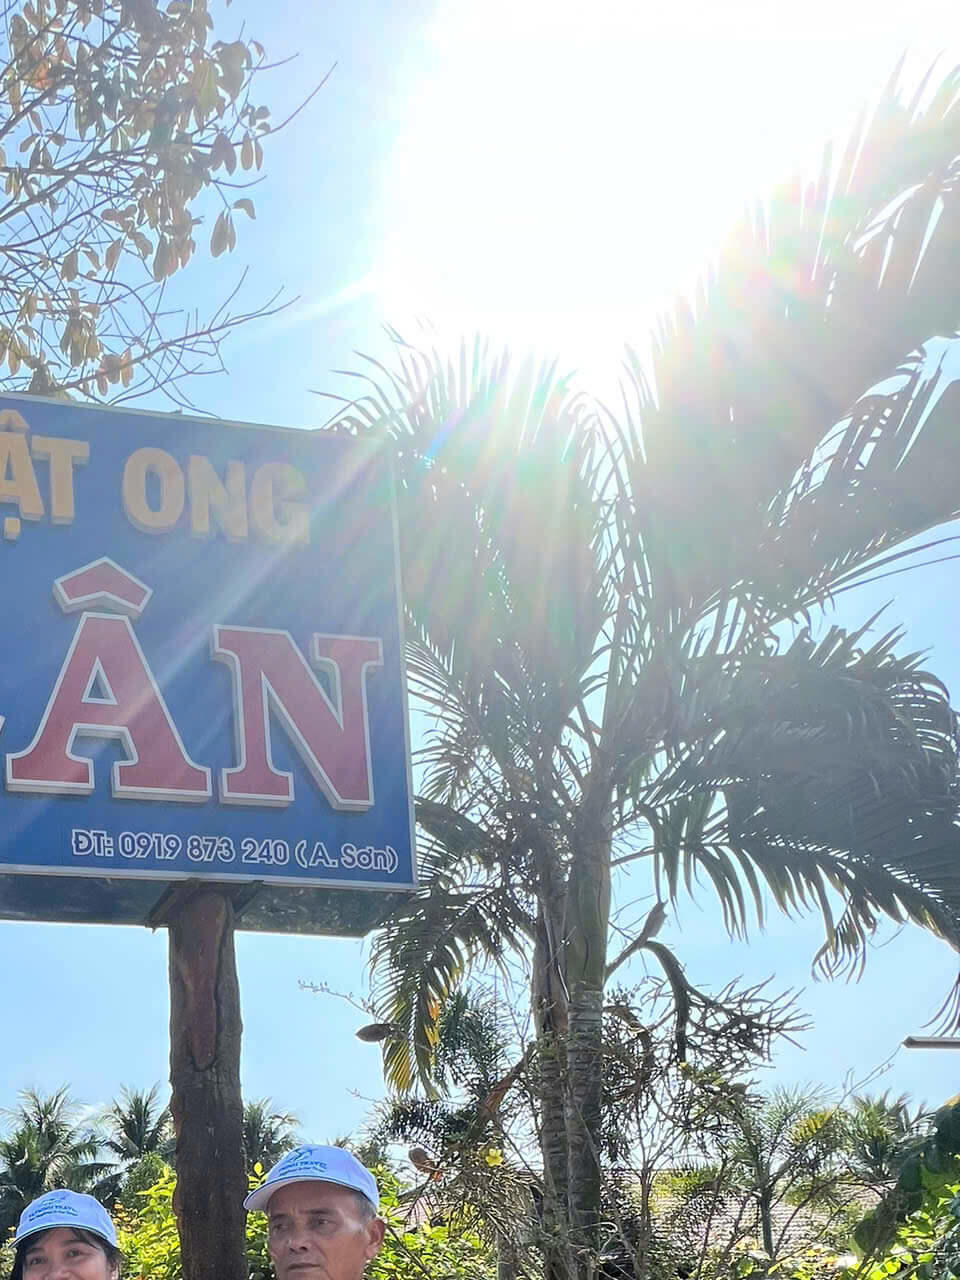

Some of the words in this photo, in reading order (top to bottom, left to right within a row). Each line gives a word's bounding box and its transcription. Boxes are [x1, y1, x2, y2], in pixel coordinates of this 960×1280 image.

[122, 447, 310, 545] ONG
[72, 829, 113, 857] ĐT:
[119, 832, 182, 859] 0919
[187, 836, 236, 863] 873
[241, 838, 289, 865] 240
